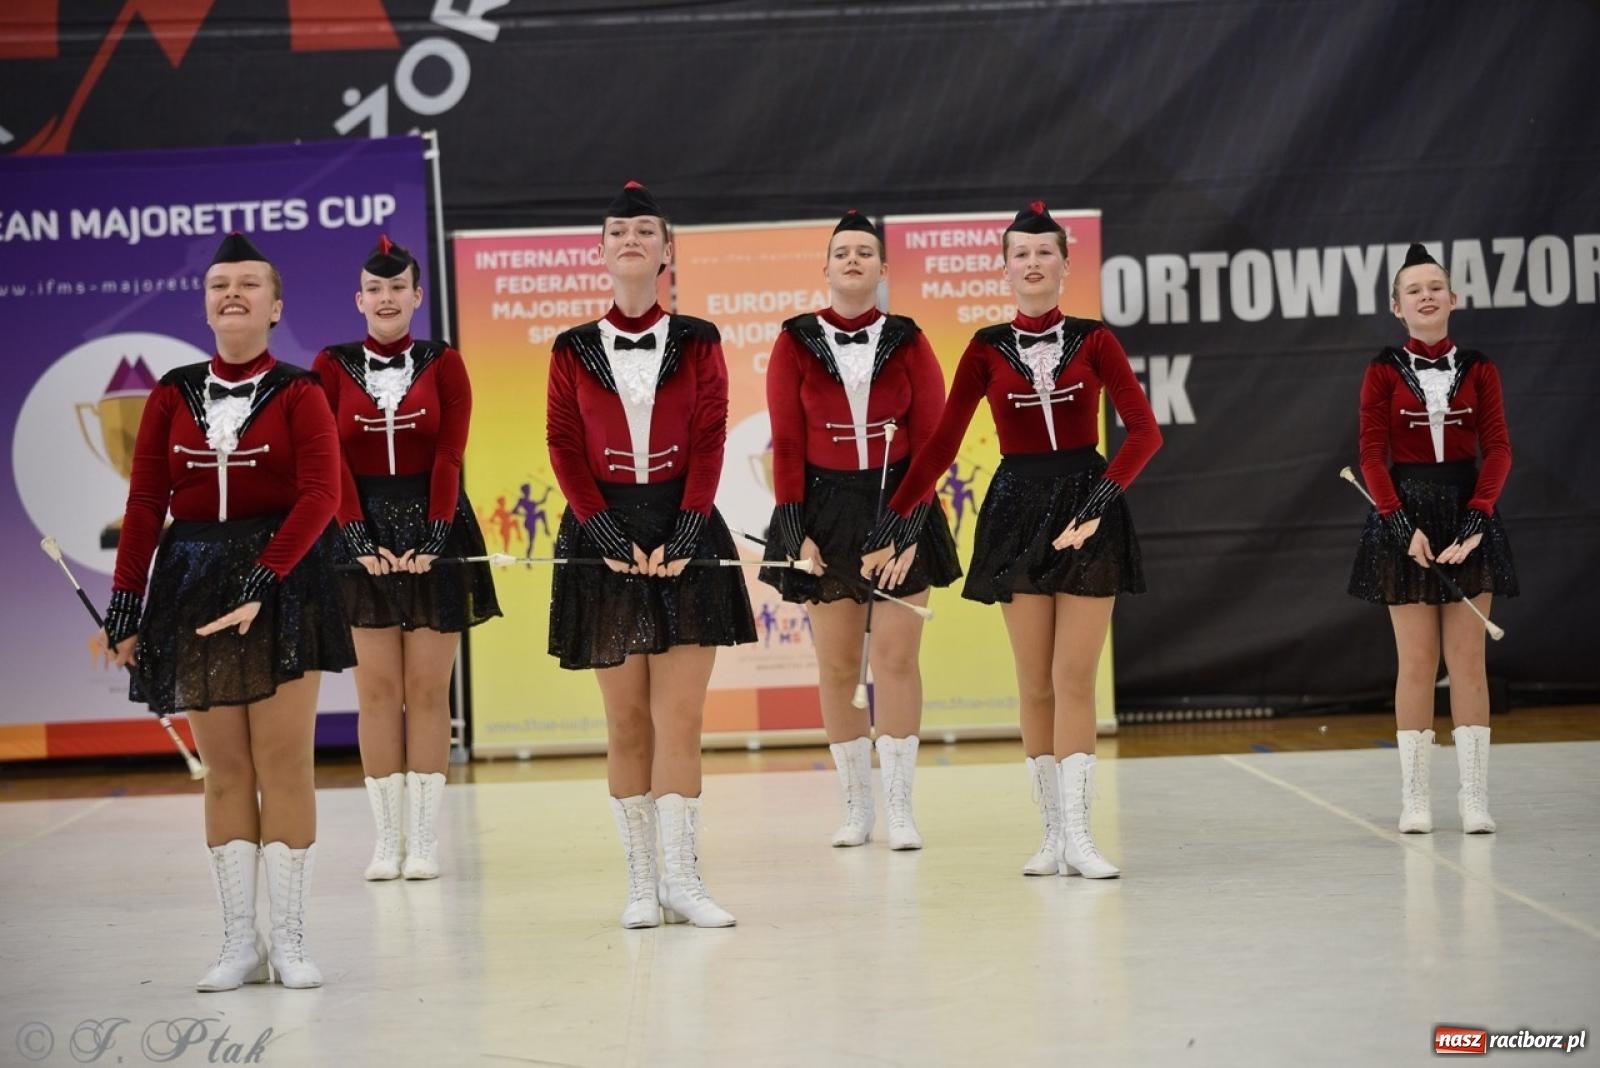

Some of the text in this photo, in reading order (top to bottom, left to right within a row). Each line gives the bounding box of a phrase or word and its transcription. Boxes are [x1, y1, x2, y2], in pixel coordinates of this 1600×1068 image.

[0, 194, 396, 245] AN MAJORETTES CUP
[720, 321, 781, 349] AJOR
